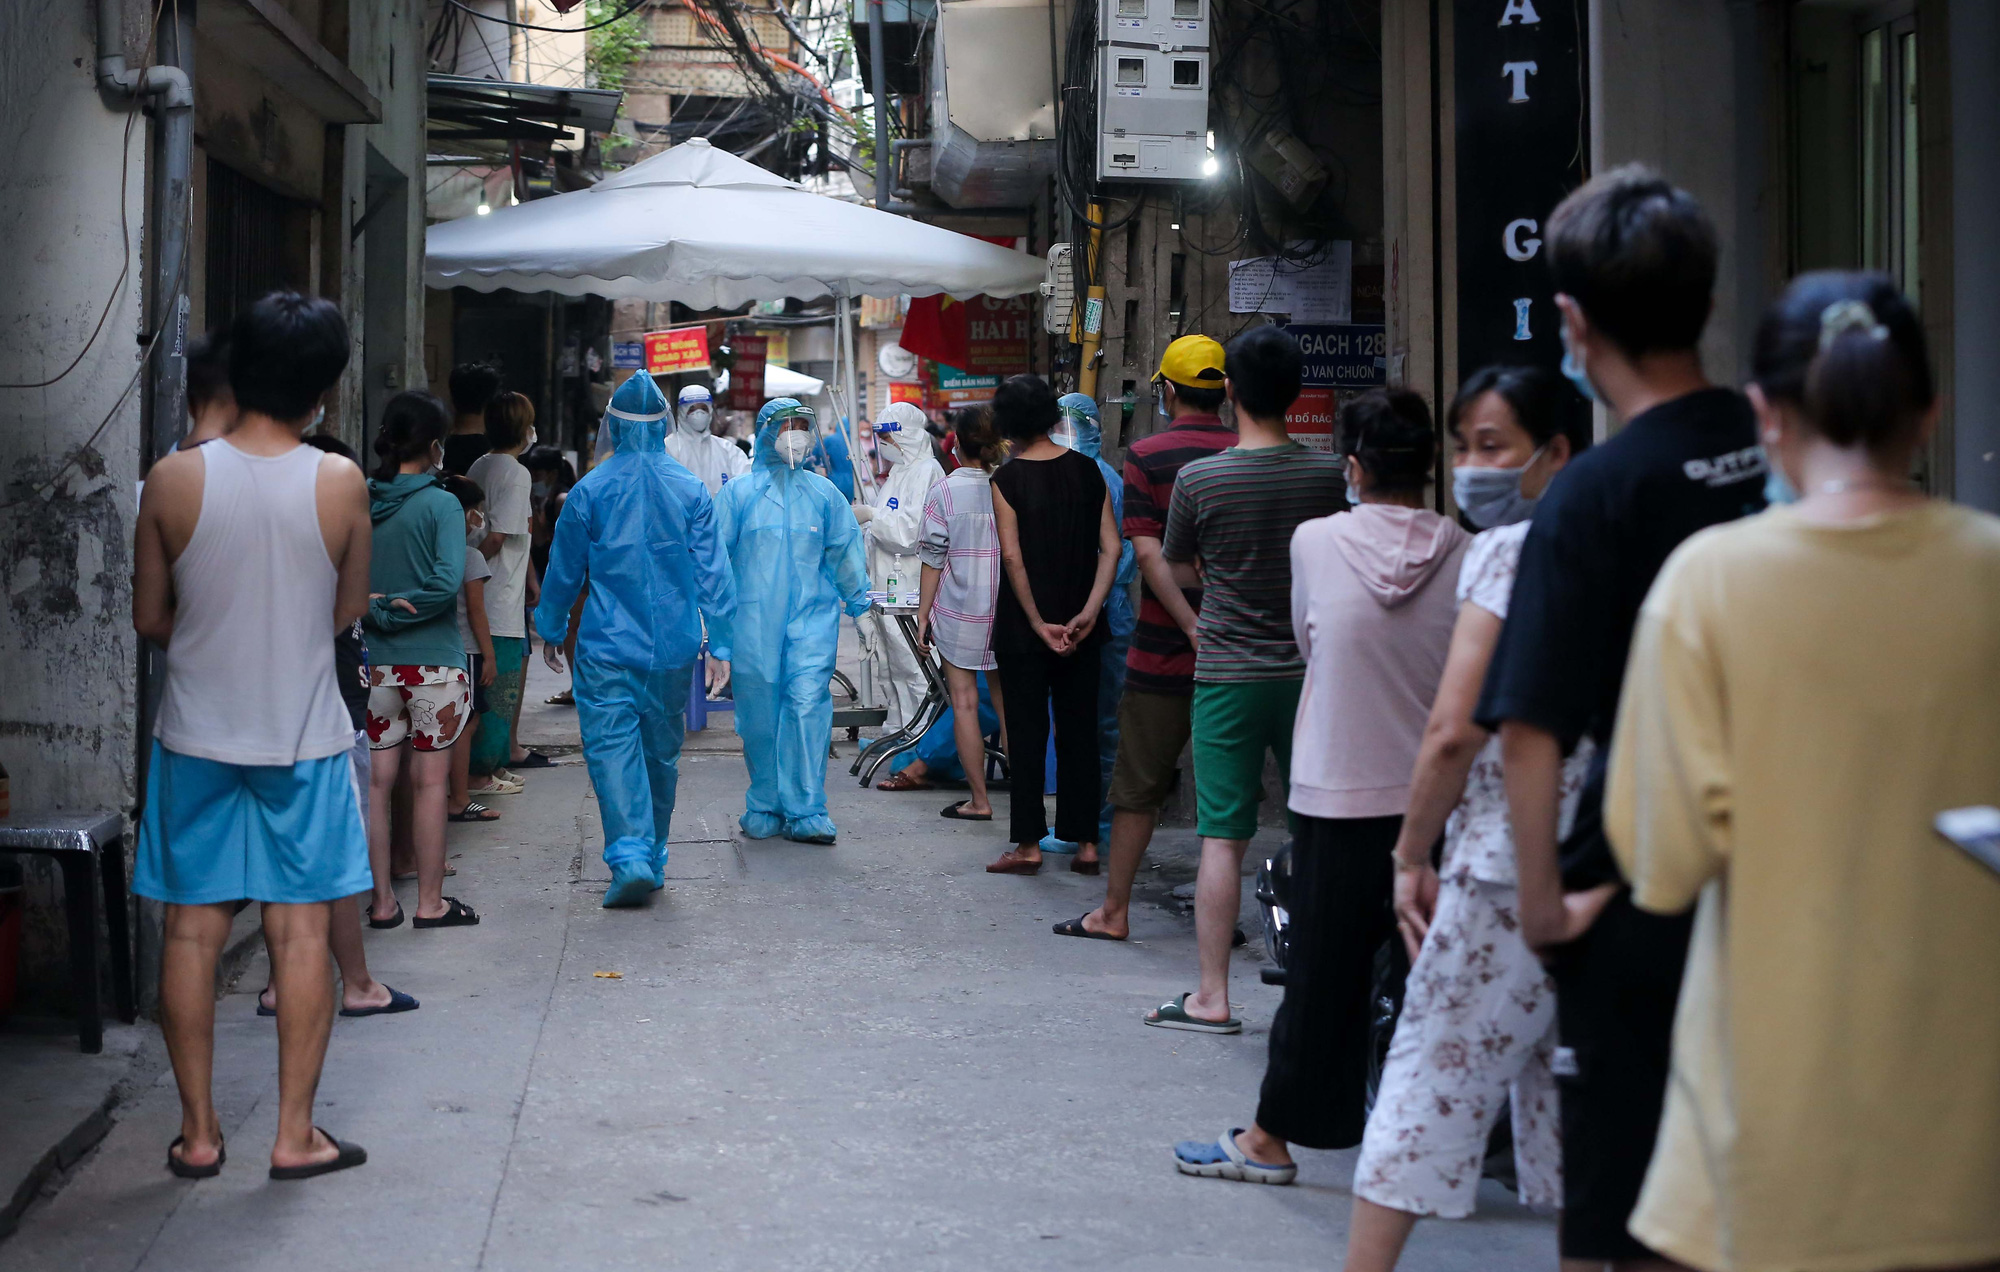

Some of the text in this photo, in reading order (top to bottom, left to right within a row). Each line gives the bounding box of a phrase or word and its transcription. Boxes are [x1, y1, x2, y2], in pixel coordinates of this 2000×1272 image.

[1295, 333, 1386, 356] GACH 128
[1312, 413, 1332, 423] RÁC
